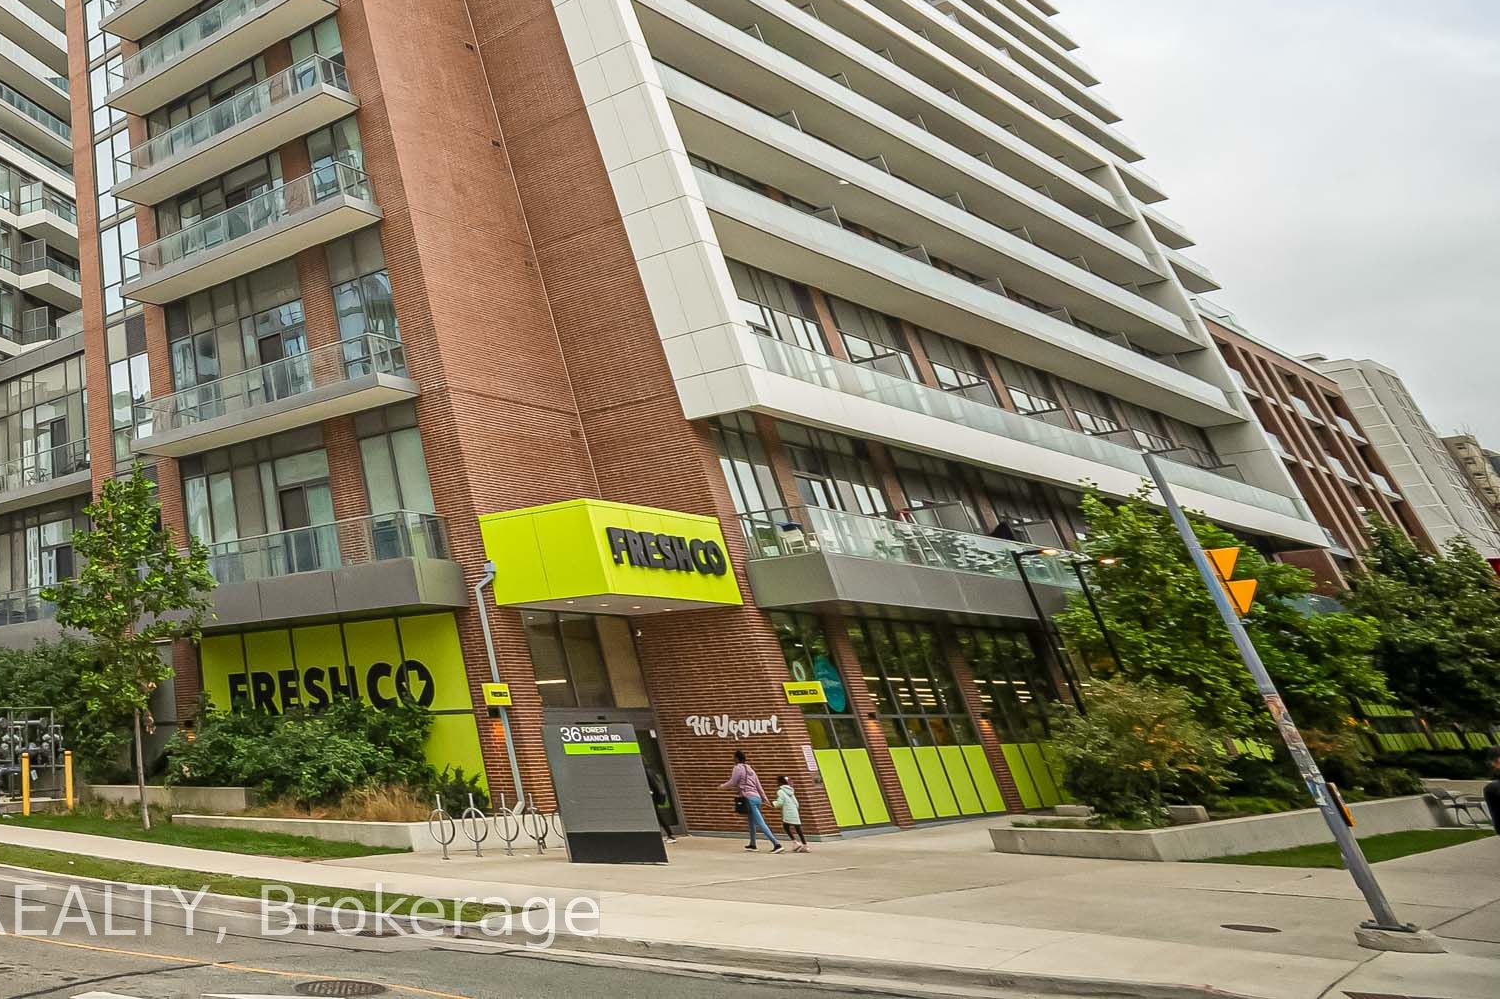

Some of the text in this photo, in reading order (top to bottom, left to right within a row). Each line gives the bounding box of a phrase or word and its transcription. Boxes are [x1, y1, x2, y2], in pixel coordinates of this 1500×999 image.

[606, 526, 727, 576] FRESHCO
[560, 726, 608, 742] 36 FOREST
[685, 714, 782, 740] Hi Yogurt
